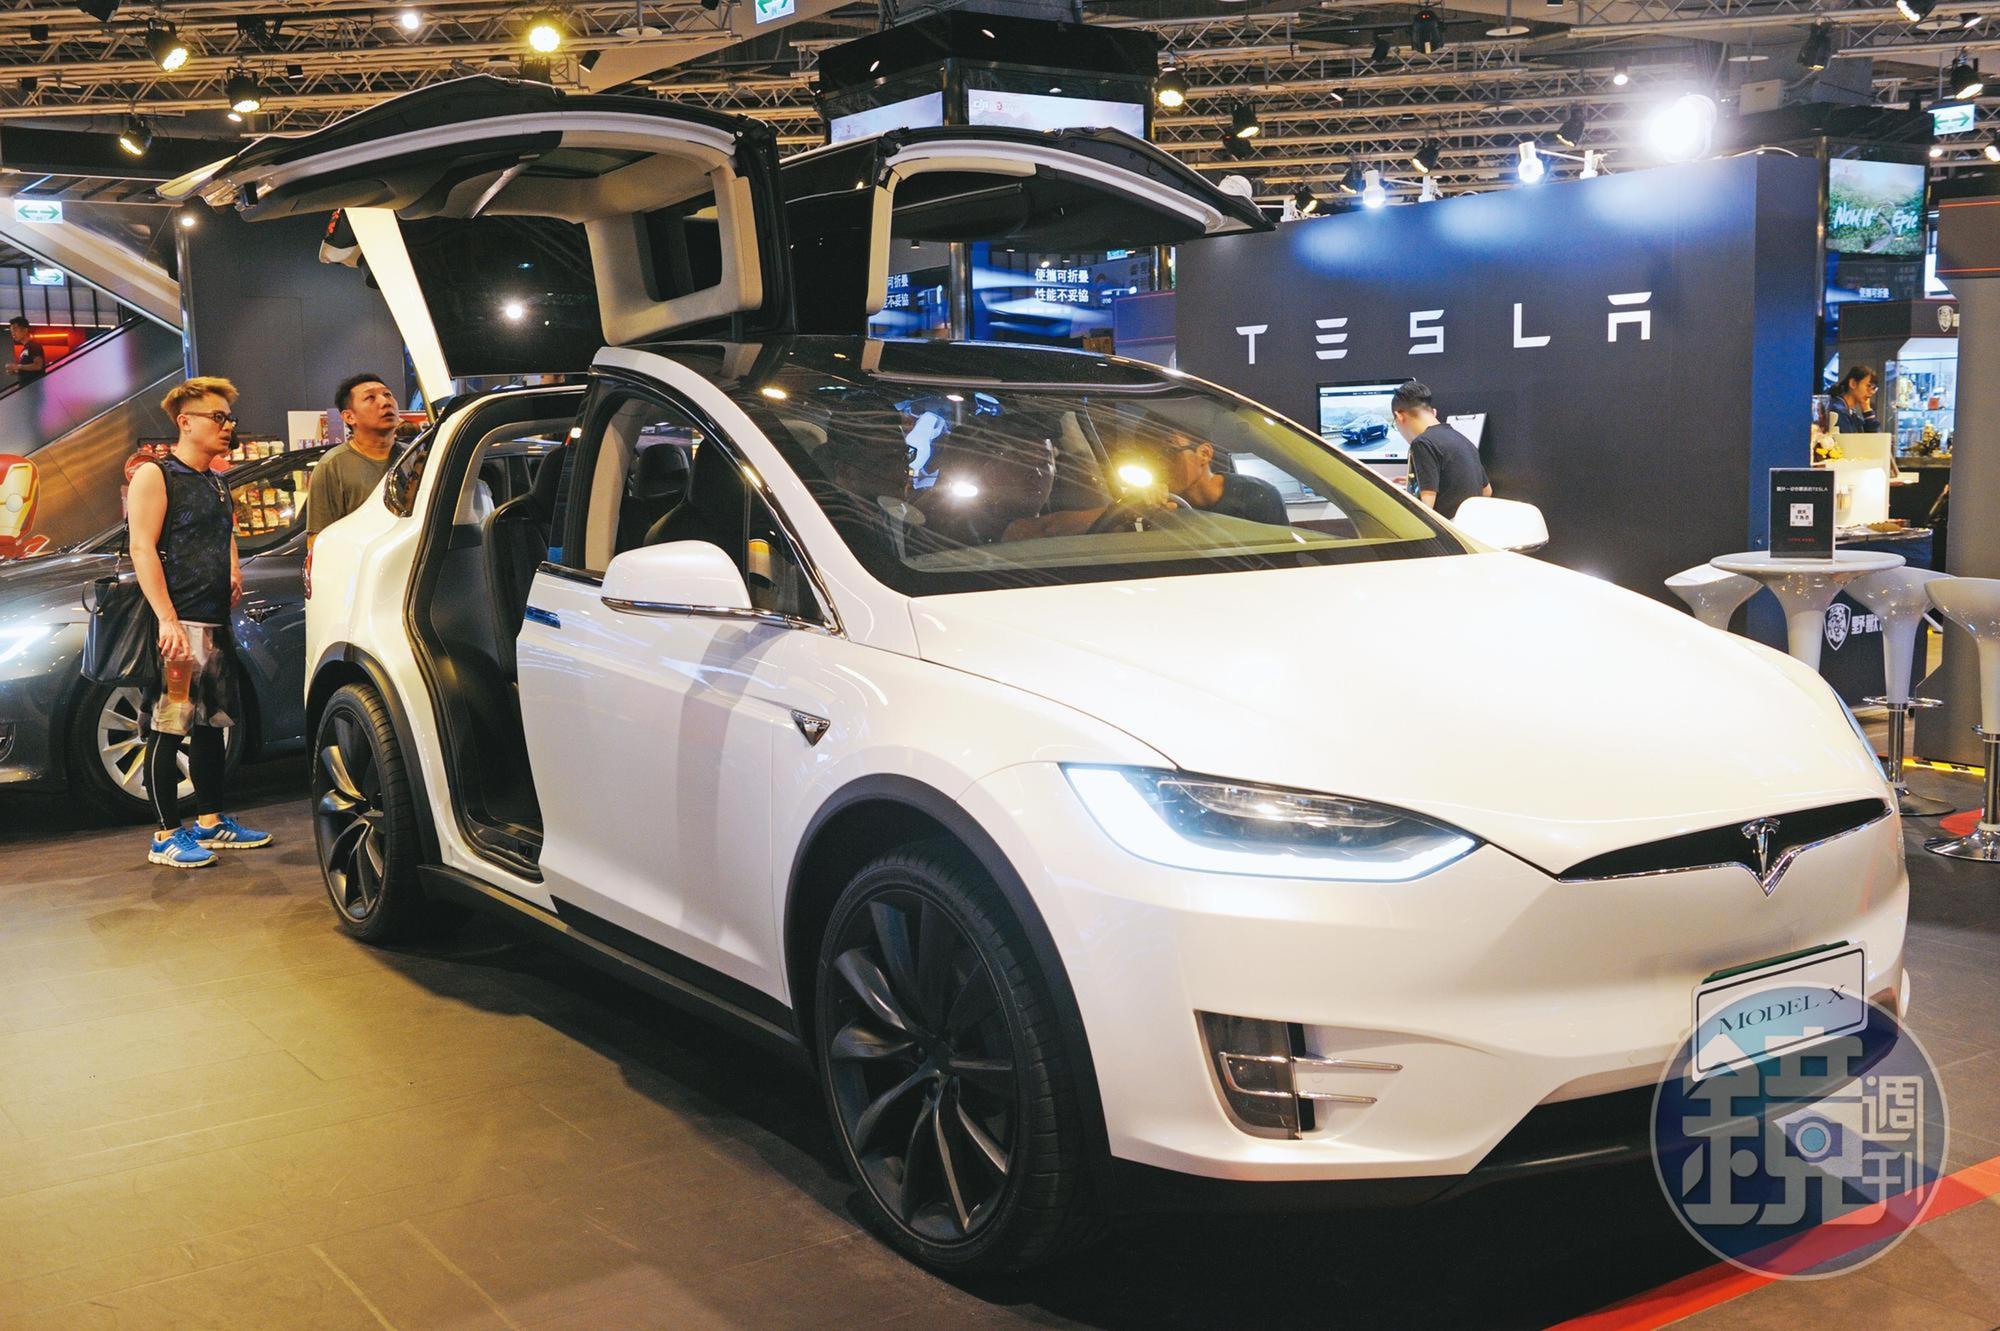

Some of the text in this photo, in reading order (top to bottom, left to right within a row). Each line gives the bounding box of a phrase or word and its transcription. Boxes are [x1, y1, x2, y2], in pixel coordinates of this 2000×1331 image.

[1035, 268, 1089, 283] 便攜可折疊
[1035, 288, 1089, 302] 性能不妥協
[1236, 292, 1652, 364] TESLA
[1851, 614, 1883, 635] 野獸
[1720, 984, 1845, 1034] MODEL X
